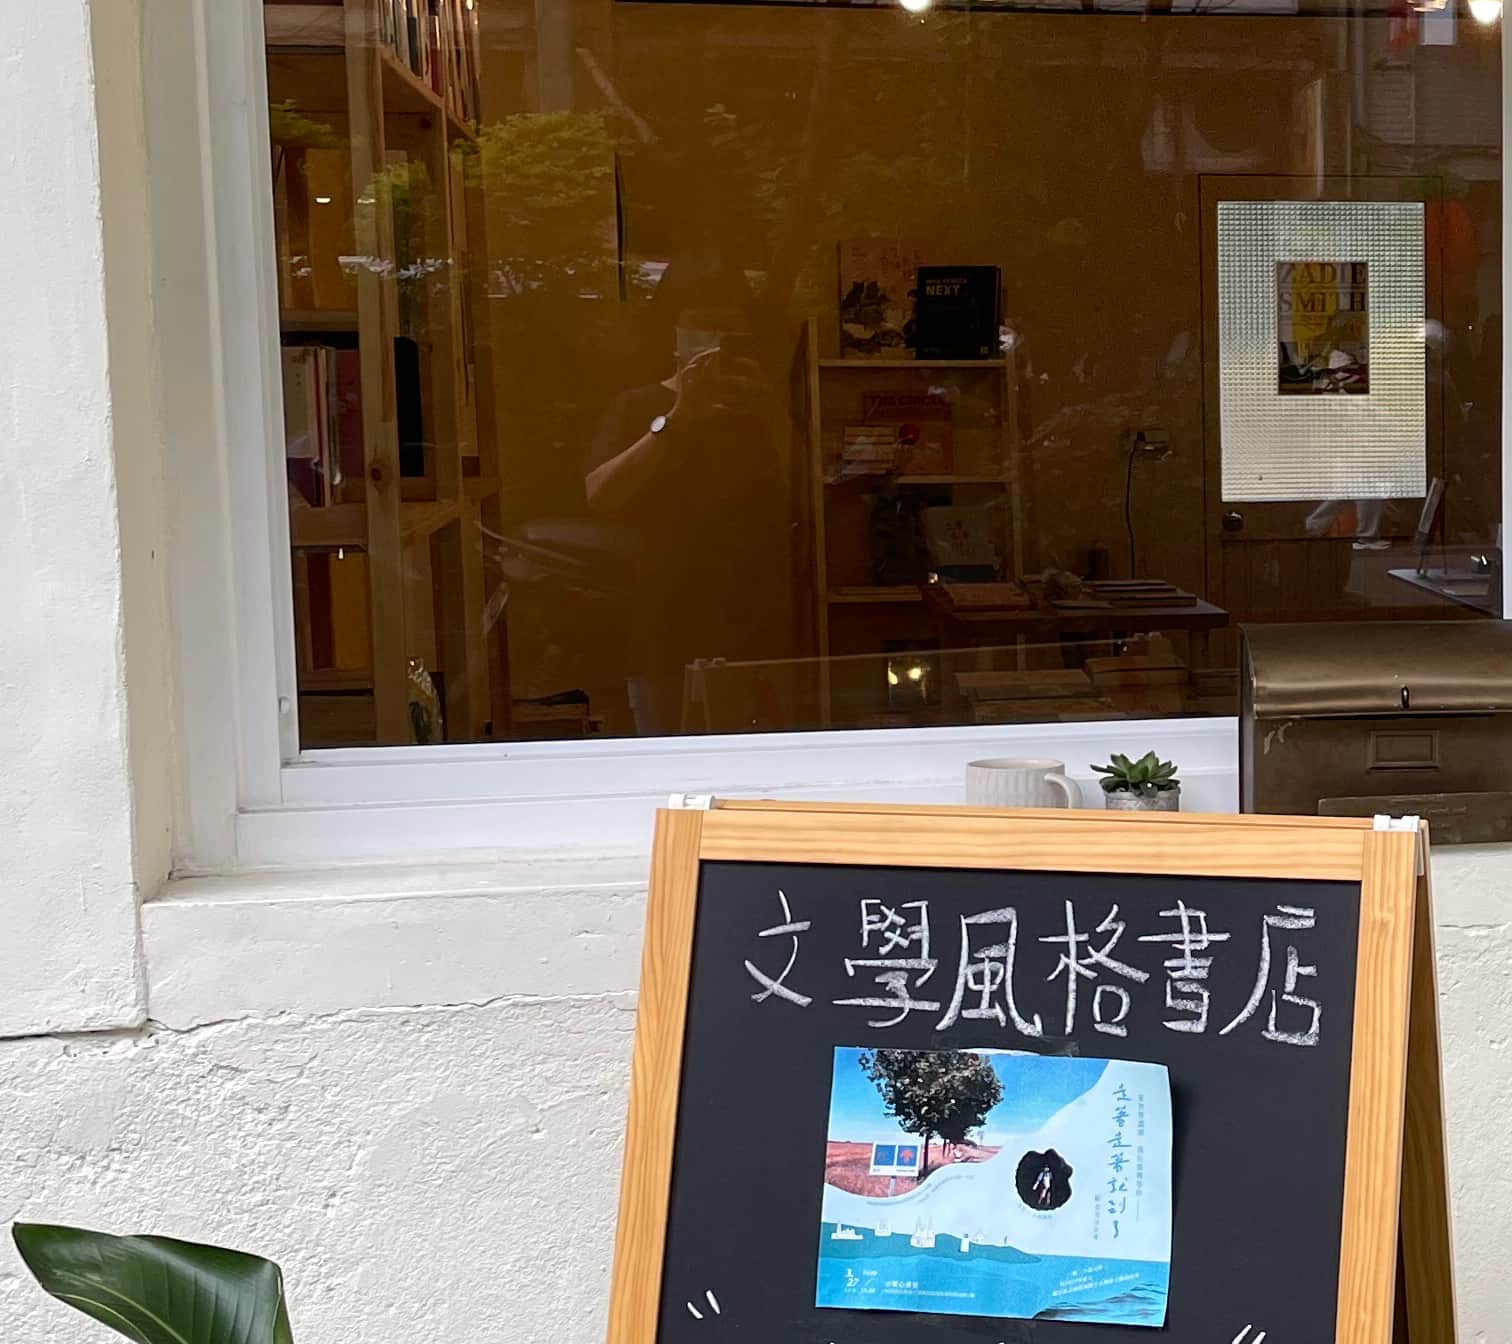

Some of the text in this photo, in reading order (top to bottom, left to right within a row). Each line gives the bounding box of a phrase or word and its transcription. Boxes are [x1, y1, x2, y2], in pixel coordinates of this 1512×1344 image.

[744, 889, 1321, 1046] 文學風格書店
